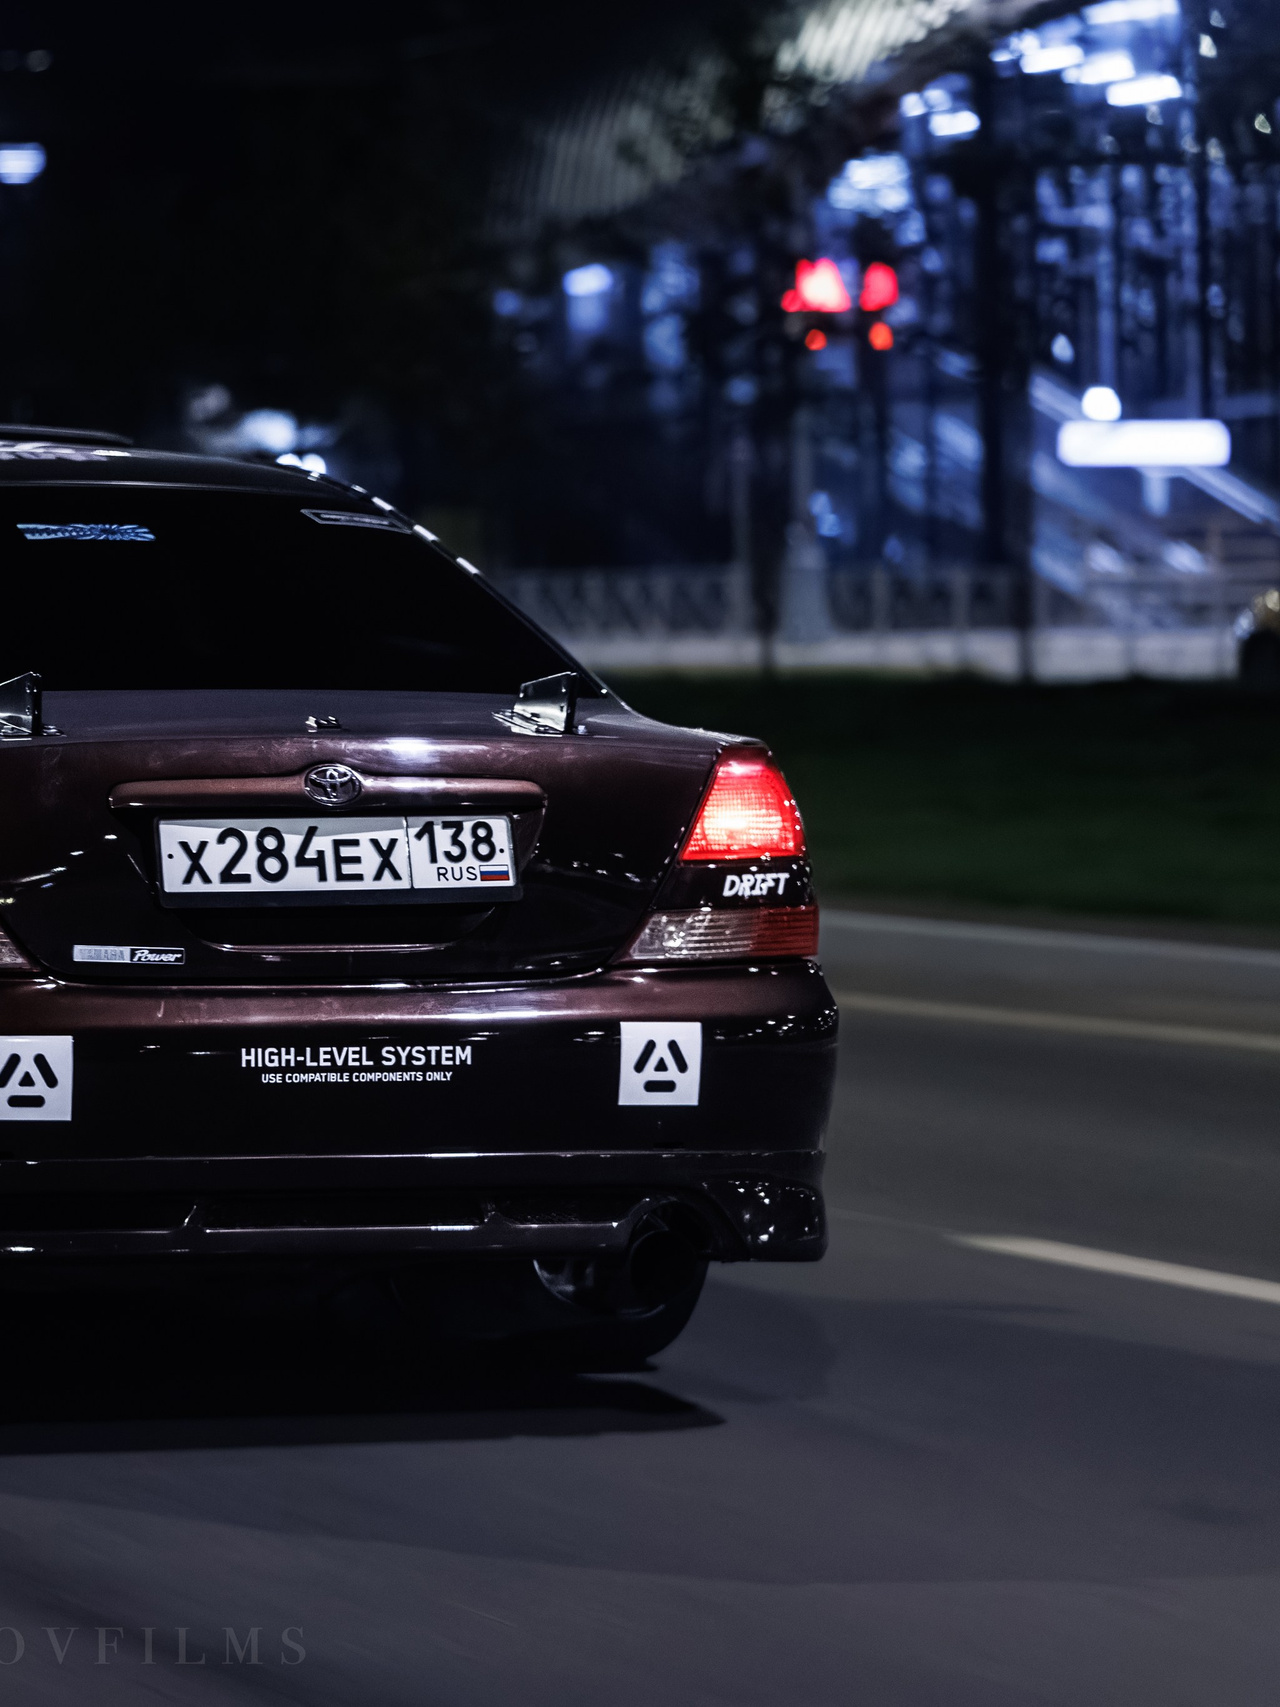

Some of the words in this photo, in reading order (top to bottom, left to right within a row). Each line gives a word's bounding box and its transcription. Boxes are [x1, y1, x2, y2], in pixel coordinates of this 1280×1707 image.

[414, 820, 497, 865] 138
[436, 866, 478, 882] RUS
[722, 872, 790, 898] DRIFT
[132, 949, 182, 962] Power
[241, 1046, 374, 1067] HIGH-LEVEL
[381, 1045, 472, 1066] SYSTEM
[261, 1073, 283, 1083] USE
[285, 1072, 350, 1083] COMPATIBLE
[352, 1071, 424, 1083] COMPONENTS
[425, 1071, 453, 1082] ONLY
